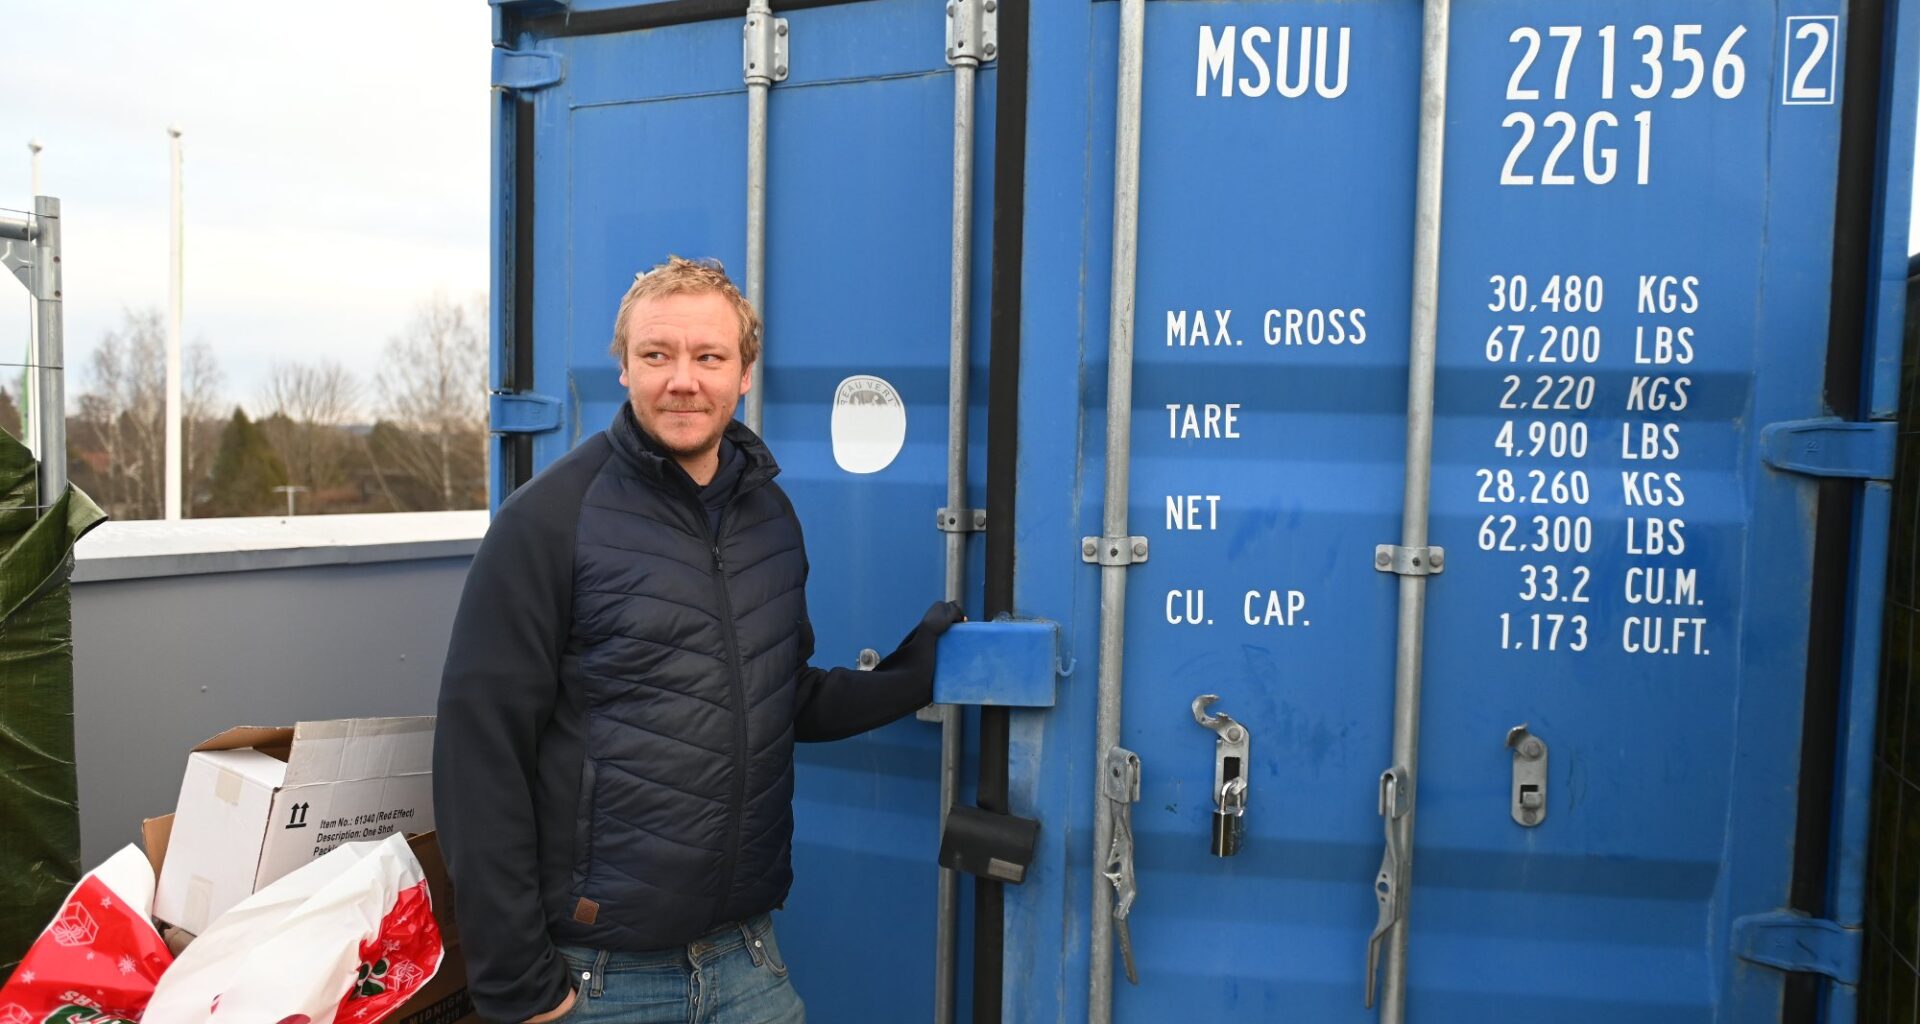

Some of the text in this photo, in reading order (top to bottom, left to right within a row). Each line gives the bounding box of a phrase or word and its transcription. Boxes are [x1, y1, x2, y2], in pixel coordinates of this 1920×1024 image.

[1196, 22, 1830, 100] MSUU 271356 2
[1500, 111, 1652, 186] 22G1
[1488, 275, 1699, 314] 30,480 KGS
[1166, 308, 1367, 346] MAX. GROSS
[1485, 325, 1695, 365] 67,200 LBS
[1499, 375, 1692, 411] 2,220 KGS
[1166, 404, 1241, 439] TARE
[1494, 420, 1680, 460] 4,900 LBS
[1475, 469, 1685, 507] 28,260 KGS
[1166, 495, 1221, 530] NET
[1478, 515, 1685, 555] 62,300 LBS
[1519, 564, 1704, 606] 33.2 CU.M.
[1166, 590, 1310, 626] CU. CAP.
[1500, 612, 1710, 655] 1,173 CU.FT.
[316, 824, 394, 843] Description: One Shot
[320, 819, 337, 829] Item
[354, 813, 375, 825] 61340
[376, 811, 392, 823] (Red
[393, 808, 415, 820] Effect)
